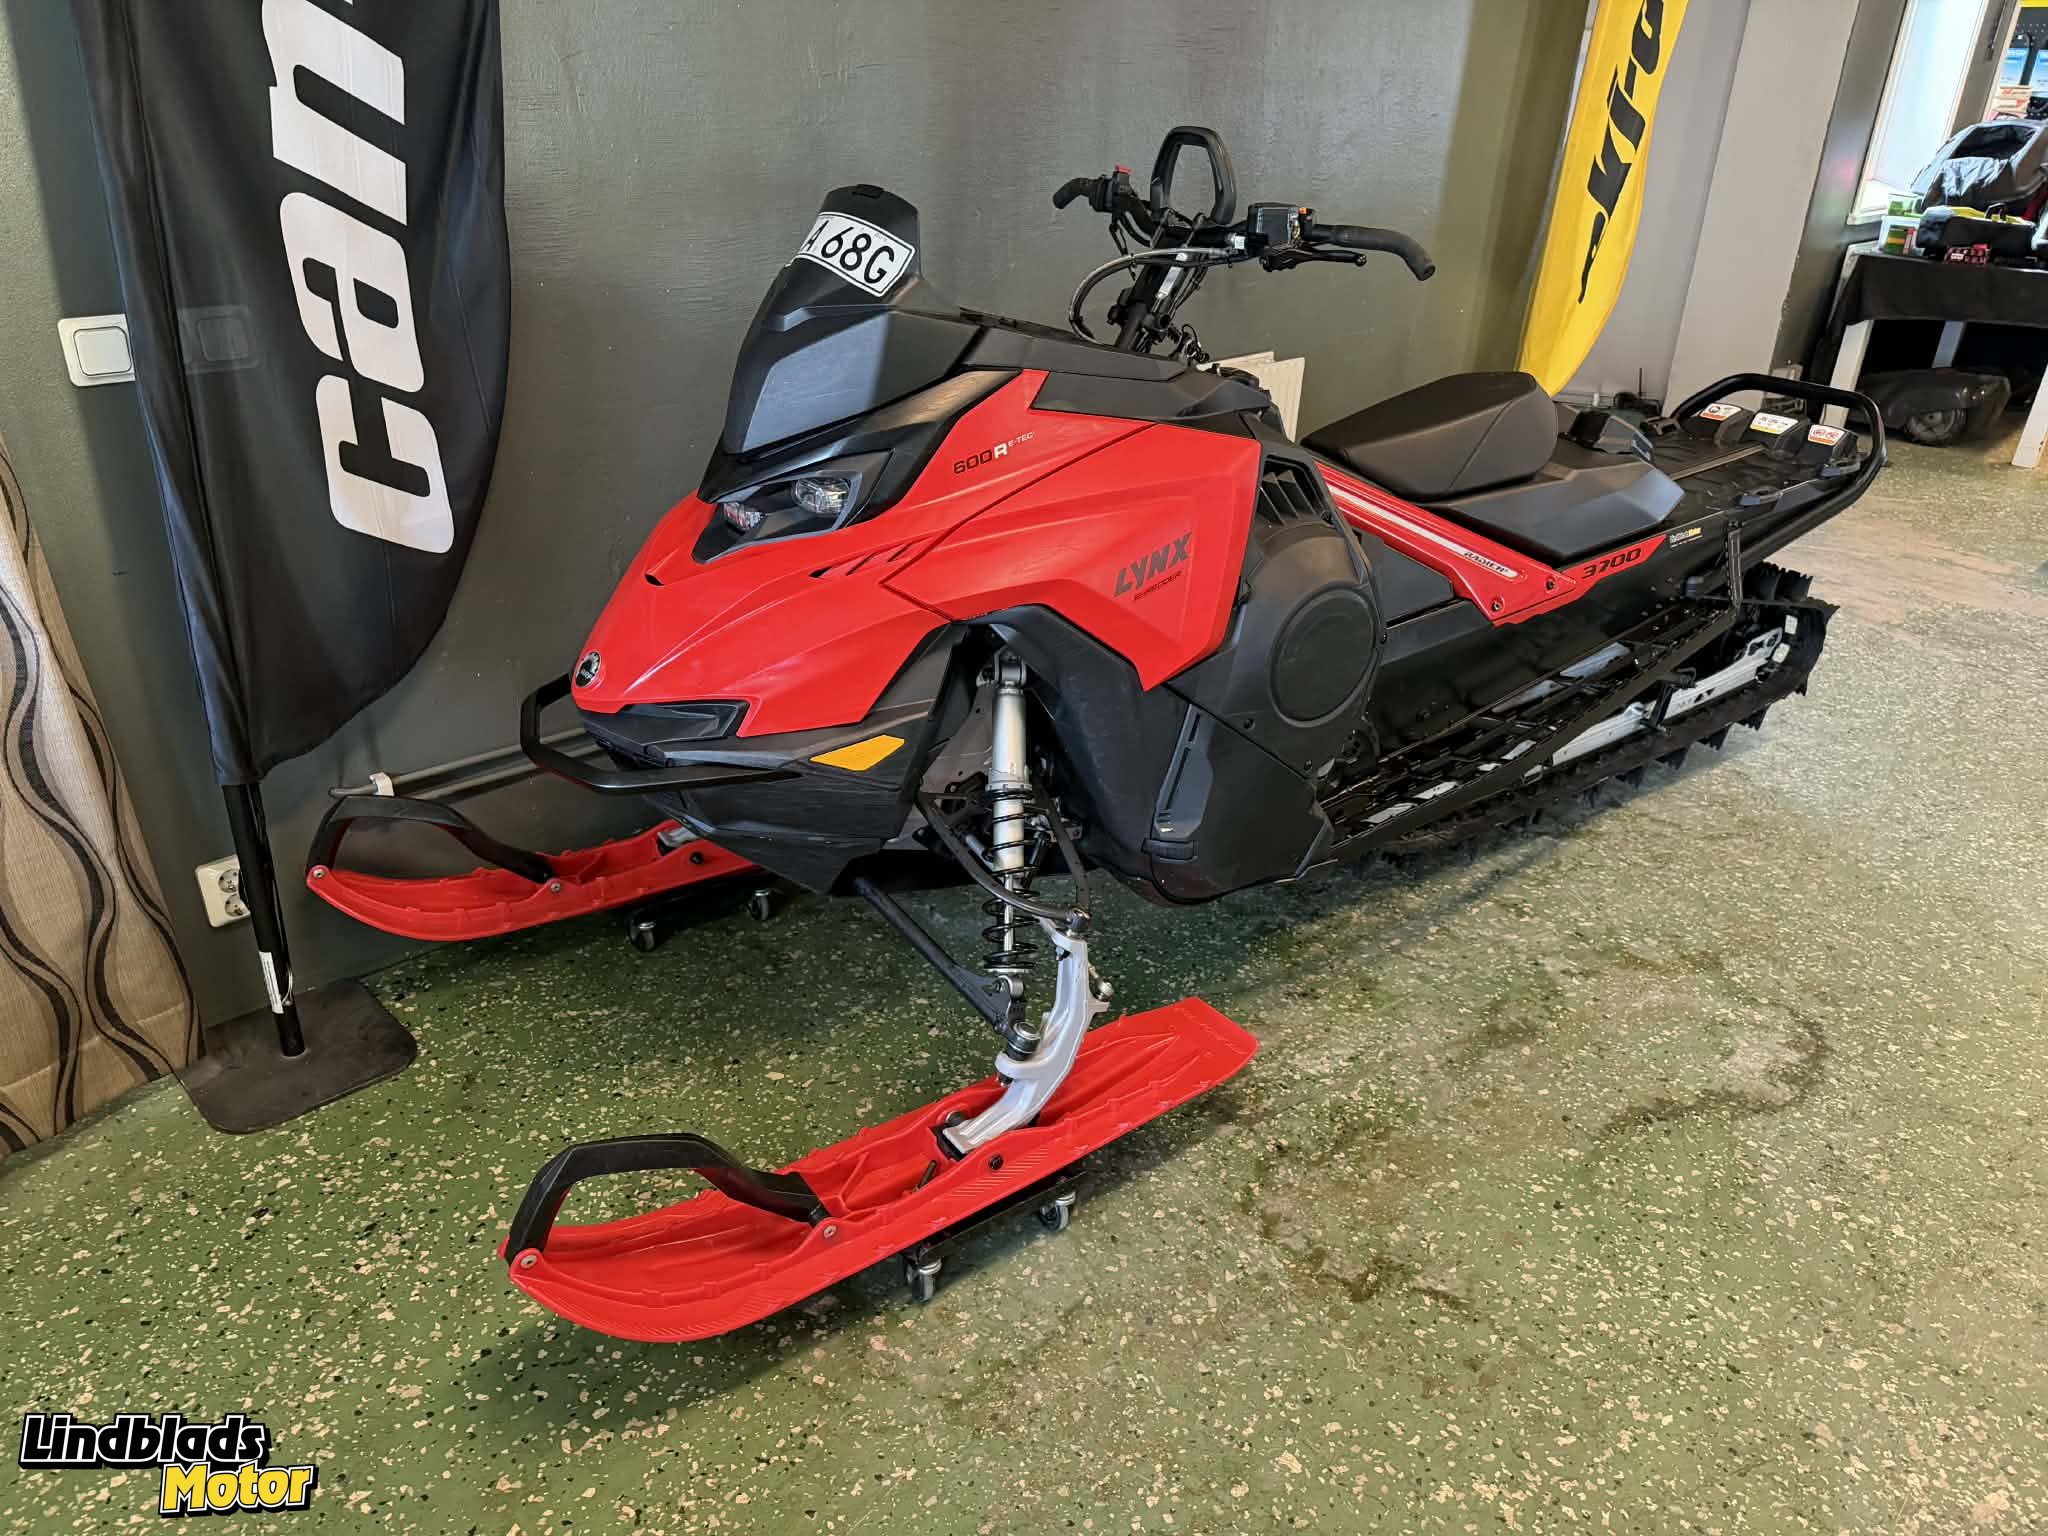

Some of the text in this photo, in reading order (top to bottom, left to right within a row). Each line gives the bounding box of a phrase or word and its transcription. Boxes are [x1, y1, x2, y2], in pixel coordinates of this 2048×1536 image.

[262, 0, 454, 554] can
[821, 226, 895, 284] 68G
[1114, 531, 1193, 597] LYNX
[1581, 547, 1642, 579] 3700
